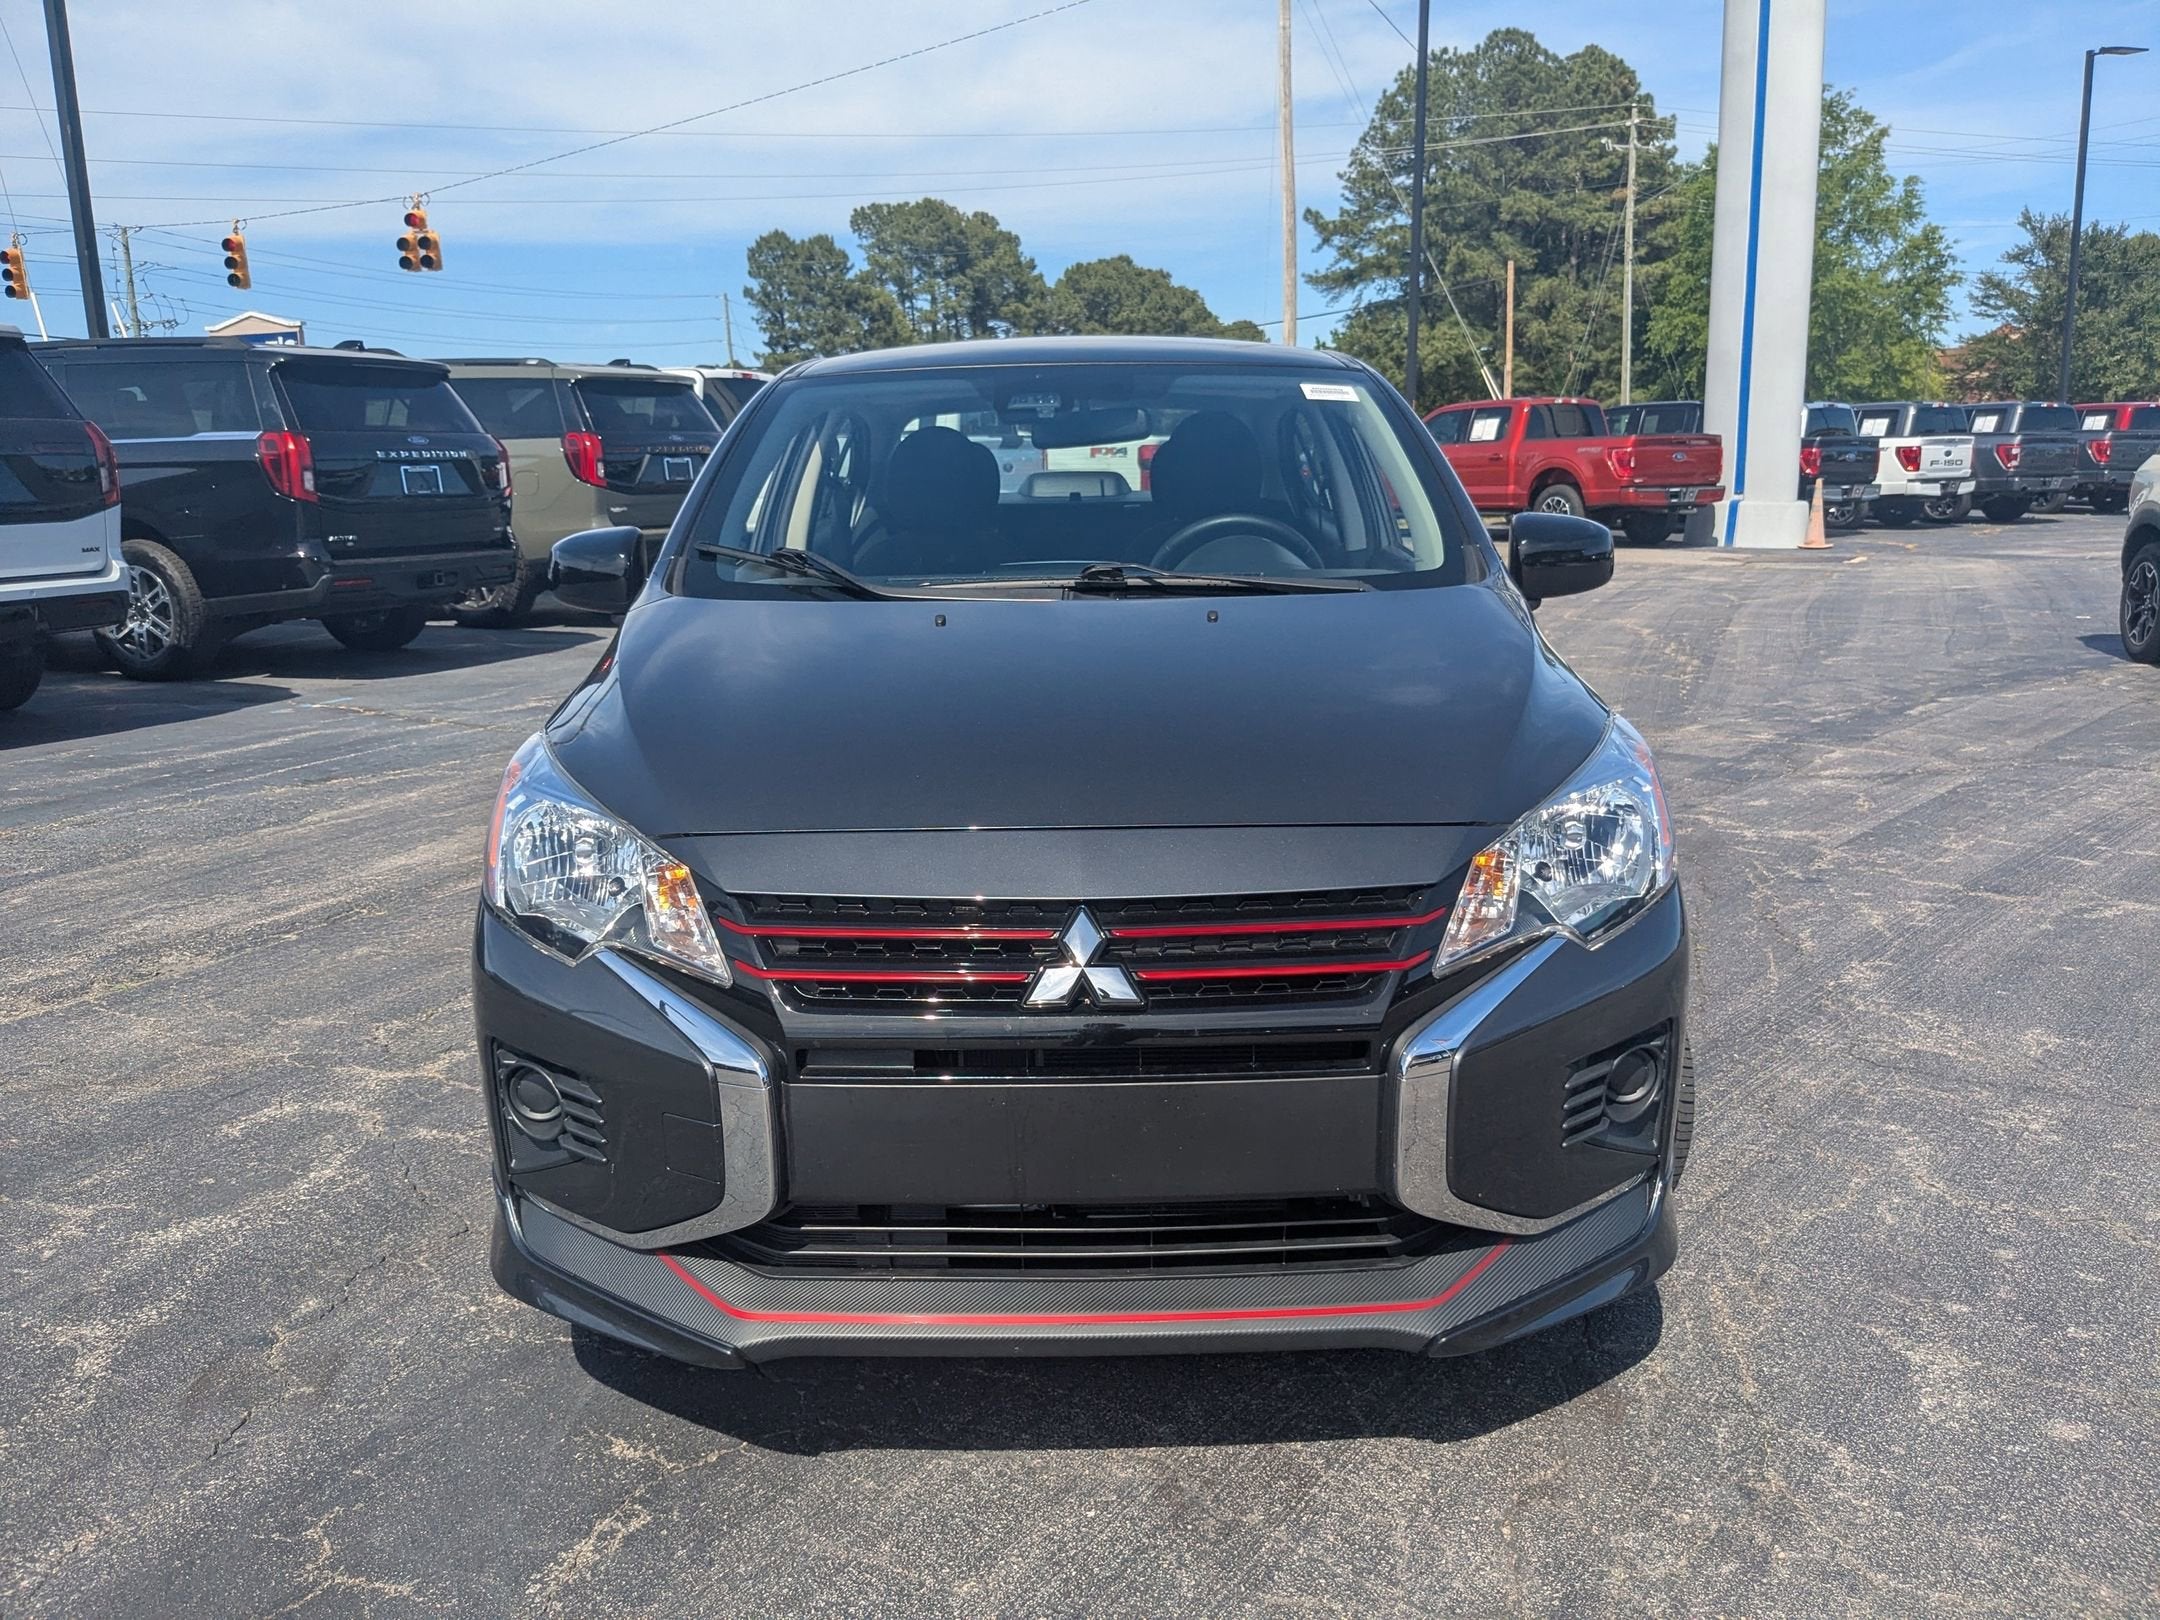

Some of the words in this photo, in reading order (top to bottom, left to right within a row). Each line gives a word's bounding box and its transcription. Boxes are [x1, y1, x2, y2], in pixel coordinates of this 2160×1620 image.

[375, 450, 468, 458] EXPEDITION
[1089, 447, 1128, 459] FX4
[1929, 459, 1964, 467] F-150
